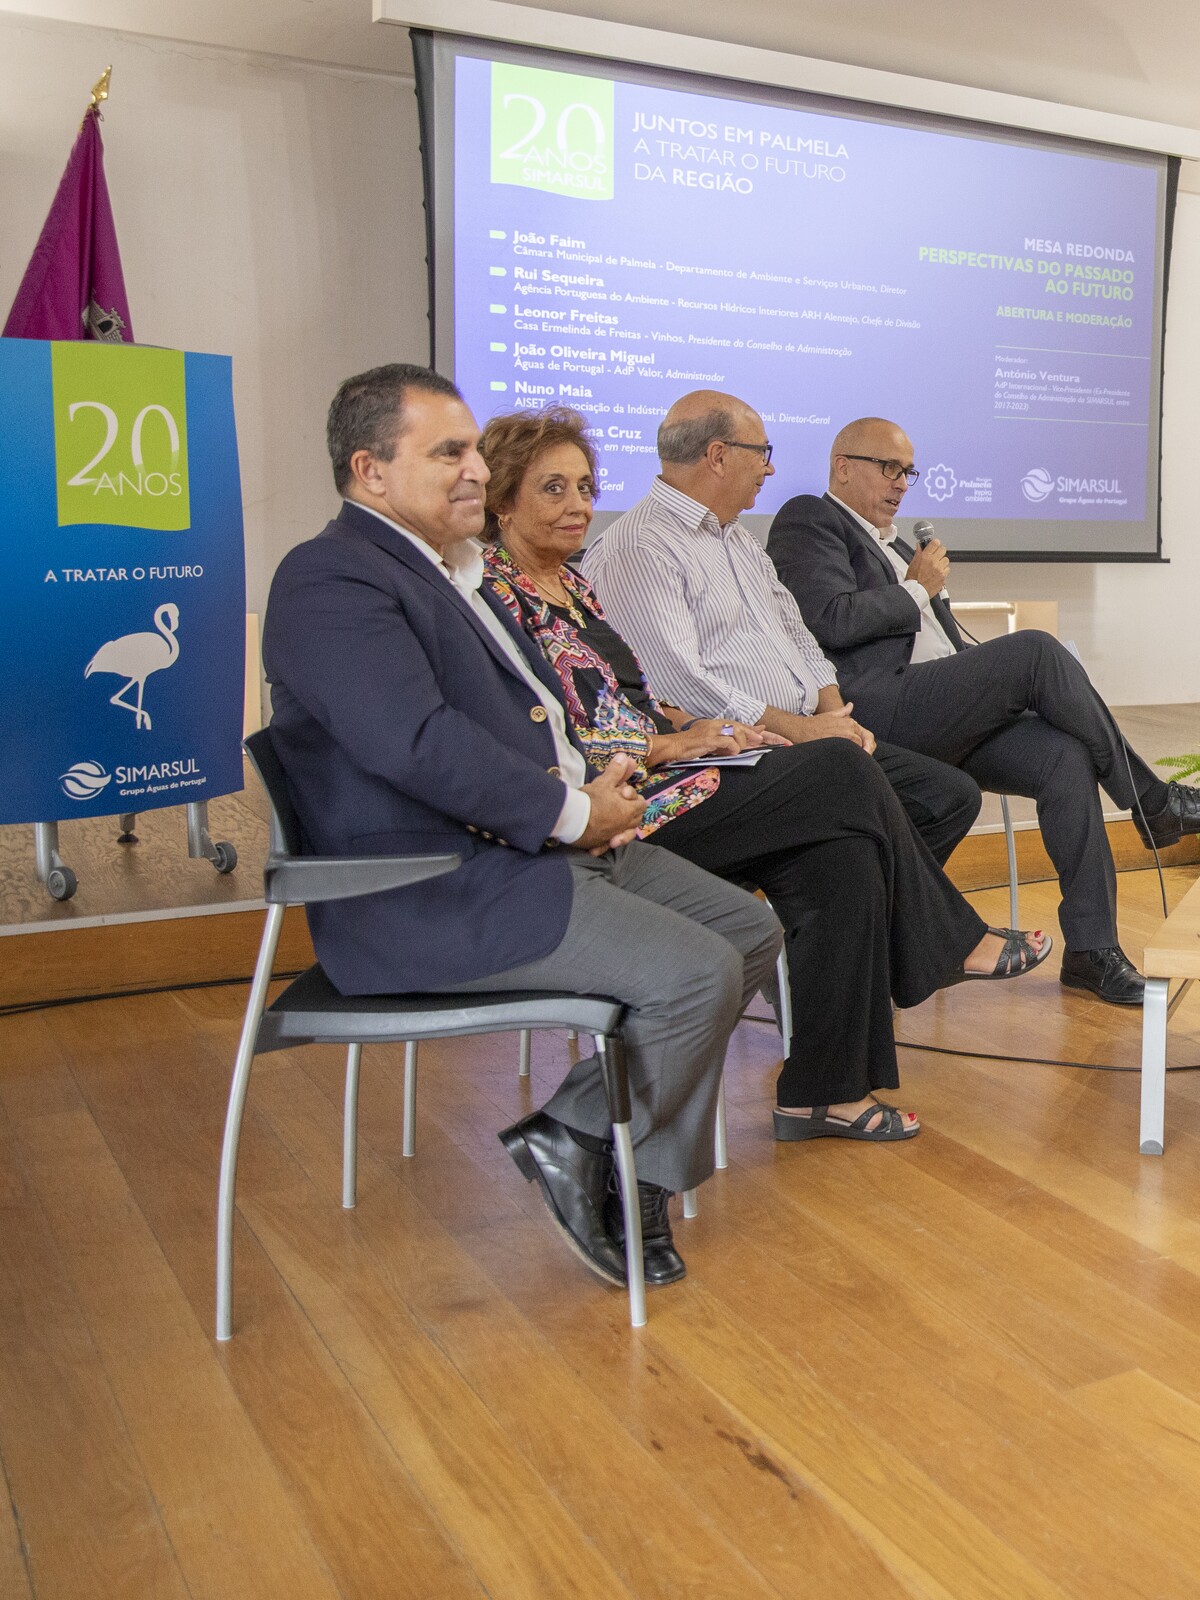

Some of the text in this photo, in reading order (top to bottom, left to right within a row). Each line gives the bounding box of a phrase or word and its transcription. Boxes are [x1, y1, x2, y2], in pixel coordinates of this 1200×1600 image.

[500, 93, 606, 159] 20
[632, 112, 849, 159] JUNTOS EM PALMELA
[522, 145, 607, 174] ANOS
[634, 138, 846, 182] A TRATAR O FUTURO
[522, 167, 606, 192] SIMARSUL
[634, 163, 753, 194] DA REGIÃO
[513, 230, 586, 249] João Faim
[1024, 238, 1134, 262] MESA REDONDA
[514, 246, 553, 258] Câmara
[557, 250, 602, 264] Municipal
[606, 255, 618, 265] de
[620, 257, 656, 269] Palmela
[666, 262, 734, 277] Departamento
[736, 270, 747, 279] de
[750, 271, 792, 284] Ambiente
[803, 277, 838, 290] Serviços
[841, 280, 878, 293] Urbanos,
[880, 284, 906, 295] Diretor
[514, 267, 604, 287] Rui Sequeira
[919, 246, 1134, 284] PERSPECTIVAS DO PASSADO
[1045, 279, 1134, 301] AO FUTURO
[514, 282, 552, 295] Agência
[554, 286, 606, 301] Portuguesa
[610, 291, 622, 301] do
[624, 294, 669, 306] Ambiente
[678, 298, 718, 310] Recursos
[720, 302, 756, 314] Hídricos
[759, 306, 798, 318] Interiores
[801, 310, 822, 320] ARH
[824, 312, 860, 326] Alentejo,
[862, 315, 882, 327] Chefe
[884, 318, 894, 327] de
[896, 319, 920, 329] Divisão
[514, 304, 618, 324] Leonor Freitas
[996, 306, 1132, 328] ABERTURA E MODERAÇÃO
[514, 320, 538, 331] Casa
[542, 322, 591, 336] Ermelinda
[594, 327, 606, 337] de
[610, 328, 641, 340] Freitas
[651, 332, 685, 344] Vinhos,
[688, 335, 730, 348] Presidente
[734, 338, 744, 348] do
[746, 340, 782, 352] Conselho
[785, 342, 795, 352] de
[798, 344, 852, 358] Administração
[514, 342, 654, 366] João Oliveira Miguel
[514, 357, 544, 370] Águas
[548, 360, 560, 370] de
[563, 362, 604, 376] Portugal
[614, 366, 634, 376] AdP
[638, 368, 663, 379] Valor,
[666, 369, 725, 382] Administrador
[994, 368, 1080, 383] António Ventura
[514, 381, 592, 398] Nuno Maia
[514, 397, 546, 408] AISET
[614, 403, 624, 413] da
[628, 404, 668, 416] Indústria
[760, 412, 831, 424] bal, Diretor-Geral
[67, 401, 180, 486] 20
[608, 426, 642, 440] Cruz
[604, 444, 618, 452] em
[93, 472, 182, 496] ANOS
[1057, 476, 1122, 493] SIMARSUL
[44, 565, 204, 582] A TRATAR O FUTURO
[116, 758, 200, 784] SIMARSUL
[120, 776, 206, 796] Grupo Águas de Portugal
